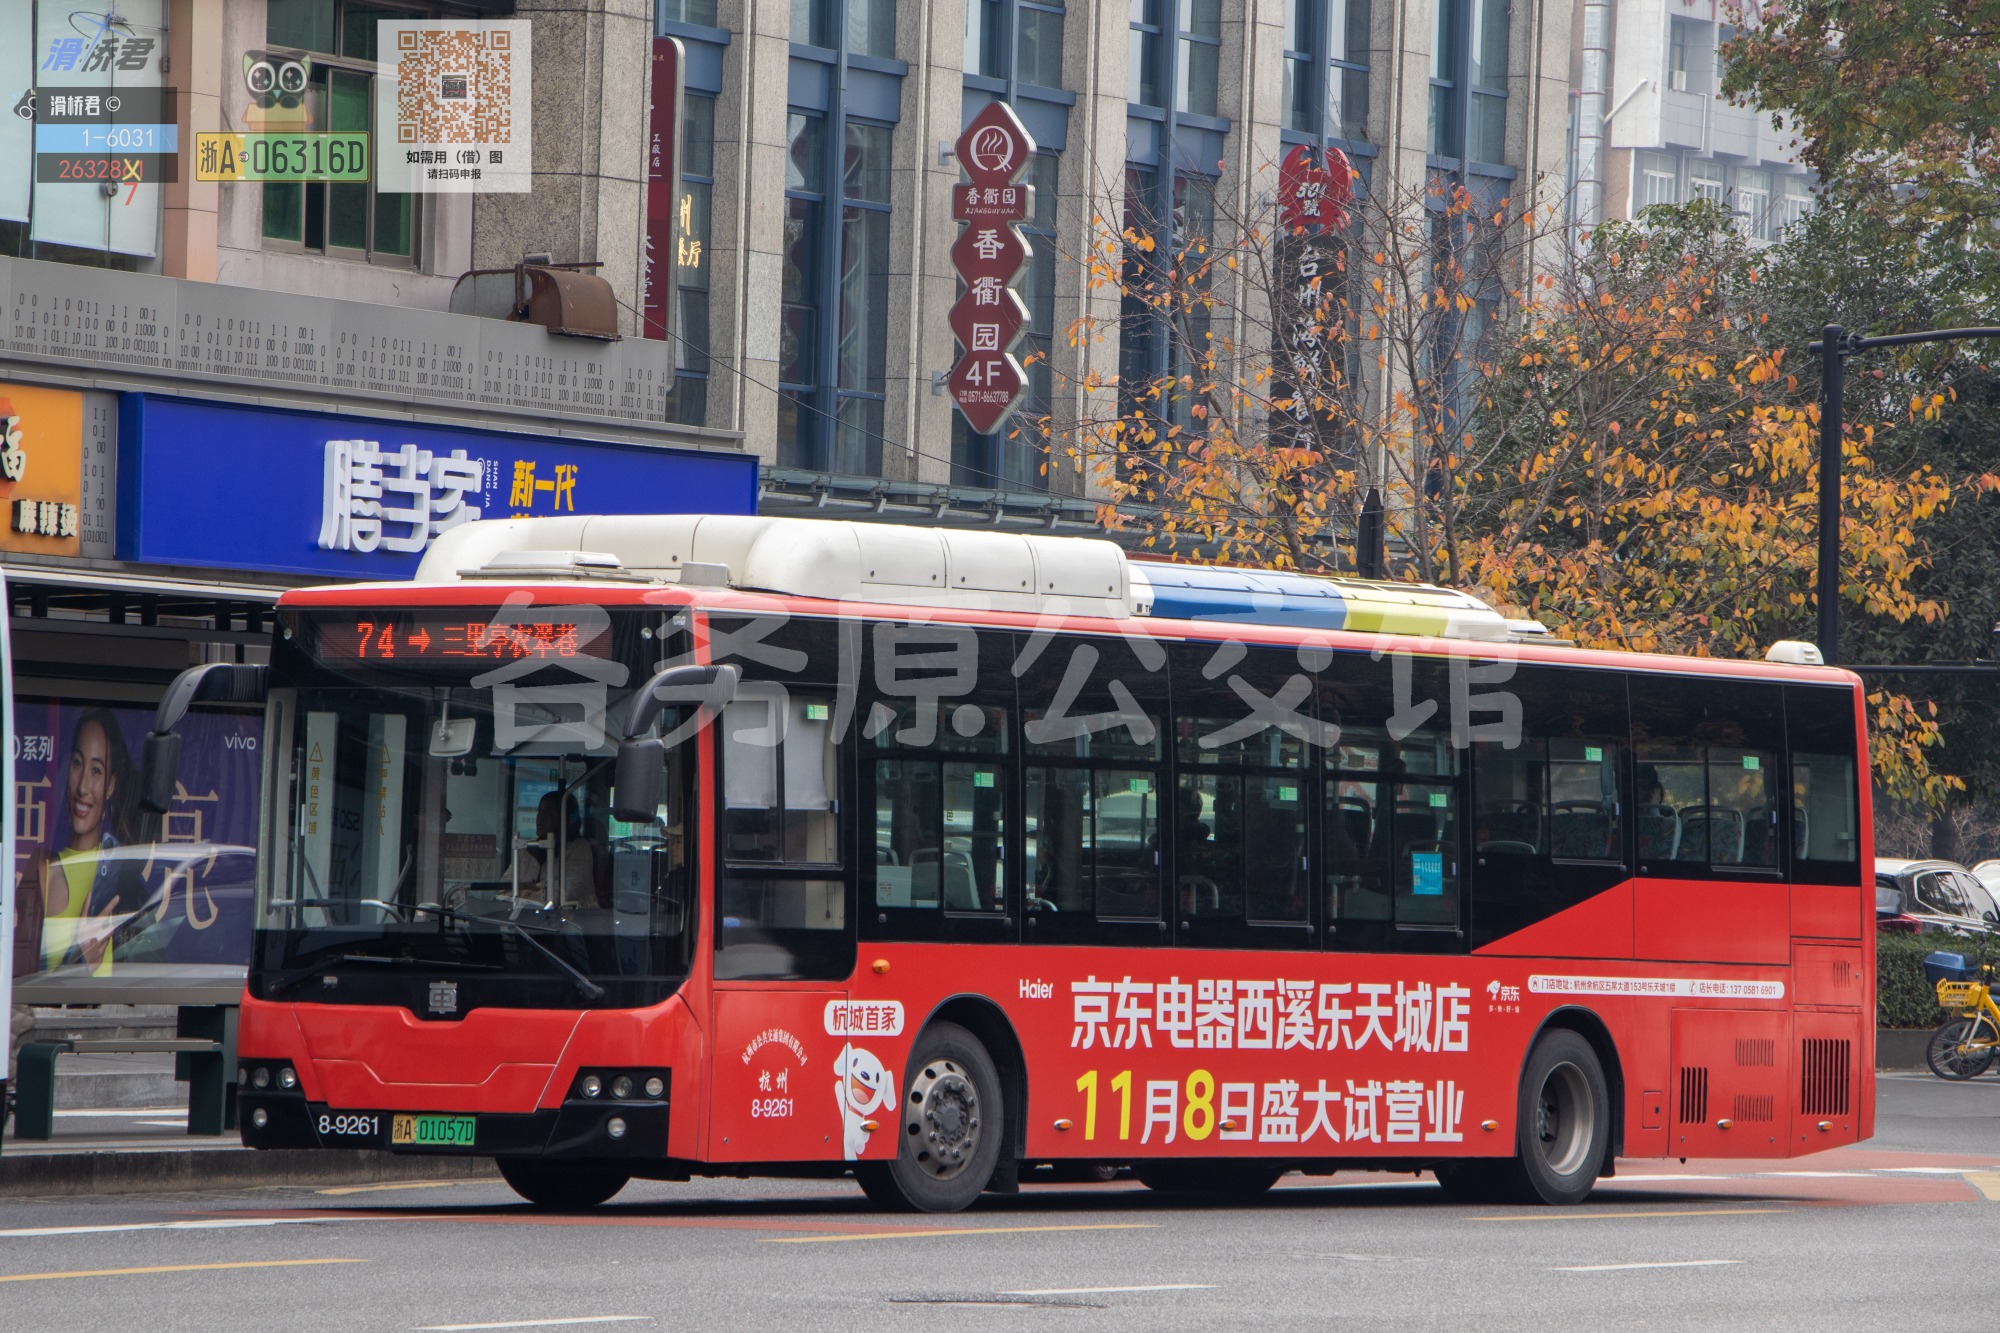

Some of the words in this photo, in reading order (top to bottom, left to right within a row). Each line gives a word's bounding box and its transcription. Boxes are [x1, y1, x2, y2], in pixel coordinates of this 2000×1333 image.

[966, 361, 1002, 386] 4F
[509, 460, 579, 512] 新一代
[357, 623, 395, 658] 74
[225, 733, 256, 750] vivo
[1019, 978, 1053, 999] Haier
[1500, 985, 1520, 1002] 京东
[832, 1005, 897, 1032] 杭城首家
[1071, 975, 1470, 1053] 京东电器西溪乐天城店
[751, 1098, 794, 1118] 8-9261
[1075, 1069, 1464, 1144] 11月8日盛大试营业
[318, 1115, 379, 1136] 8-9261
